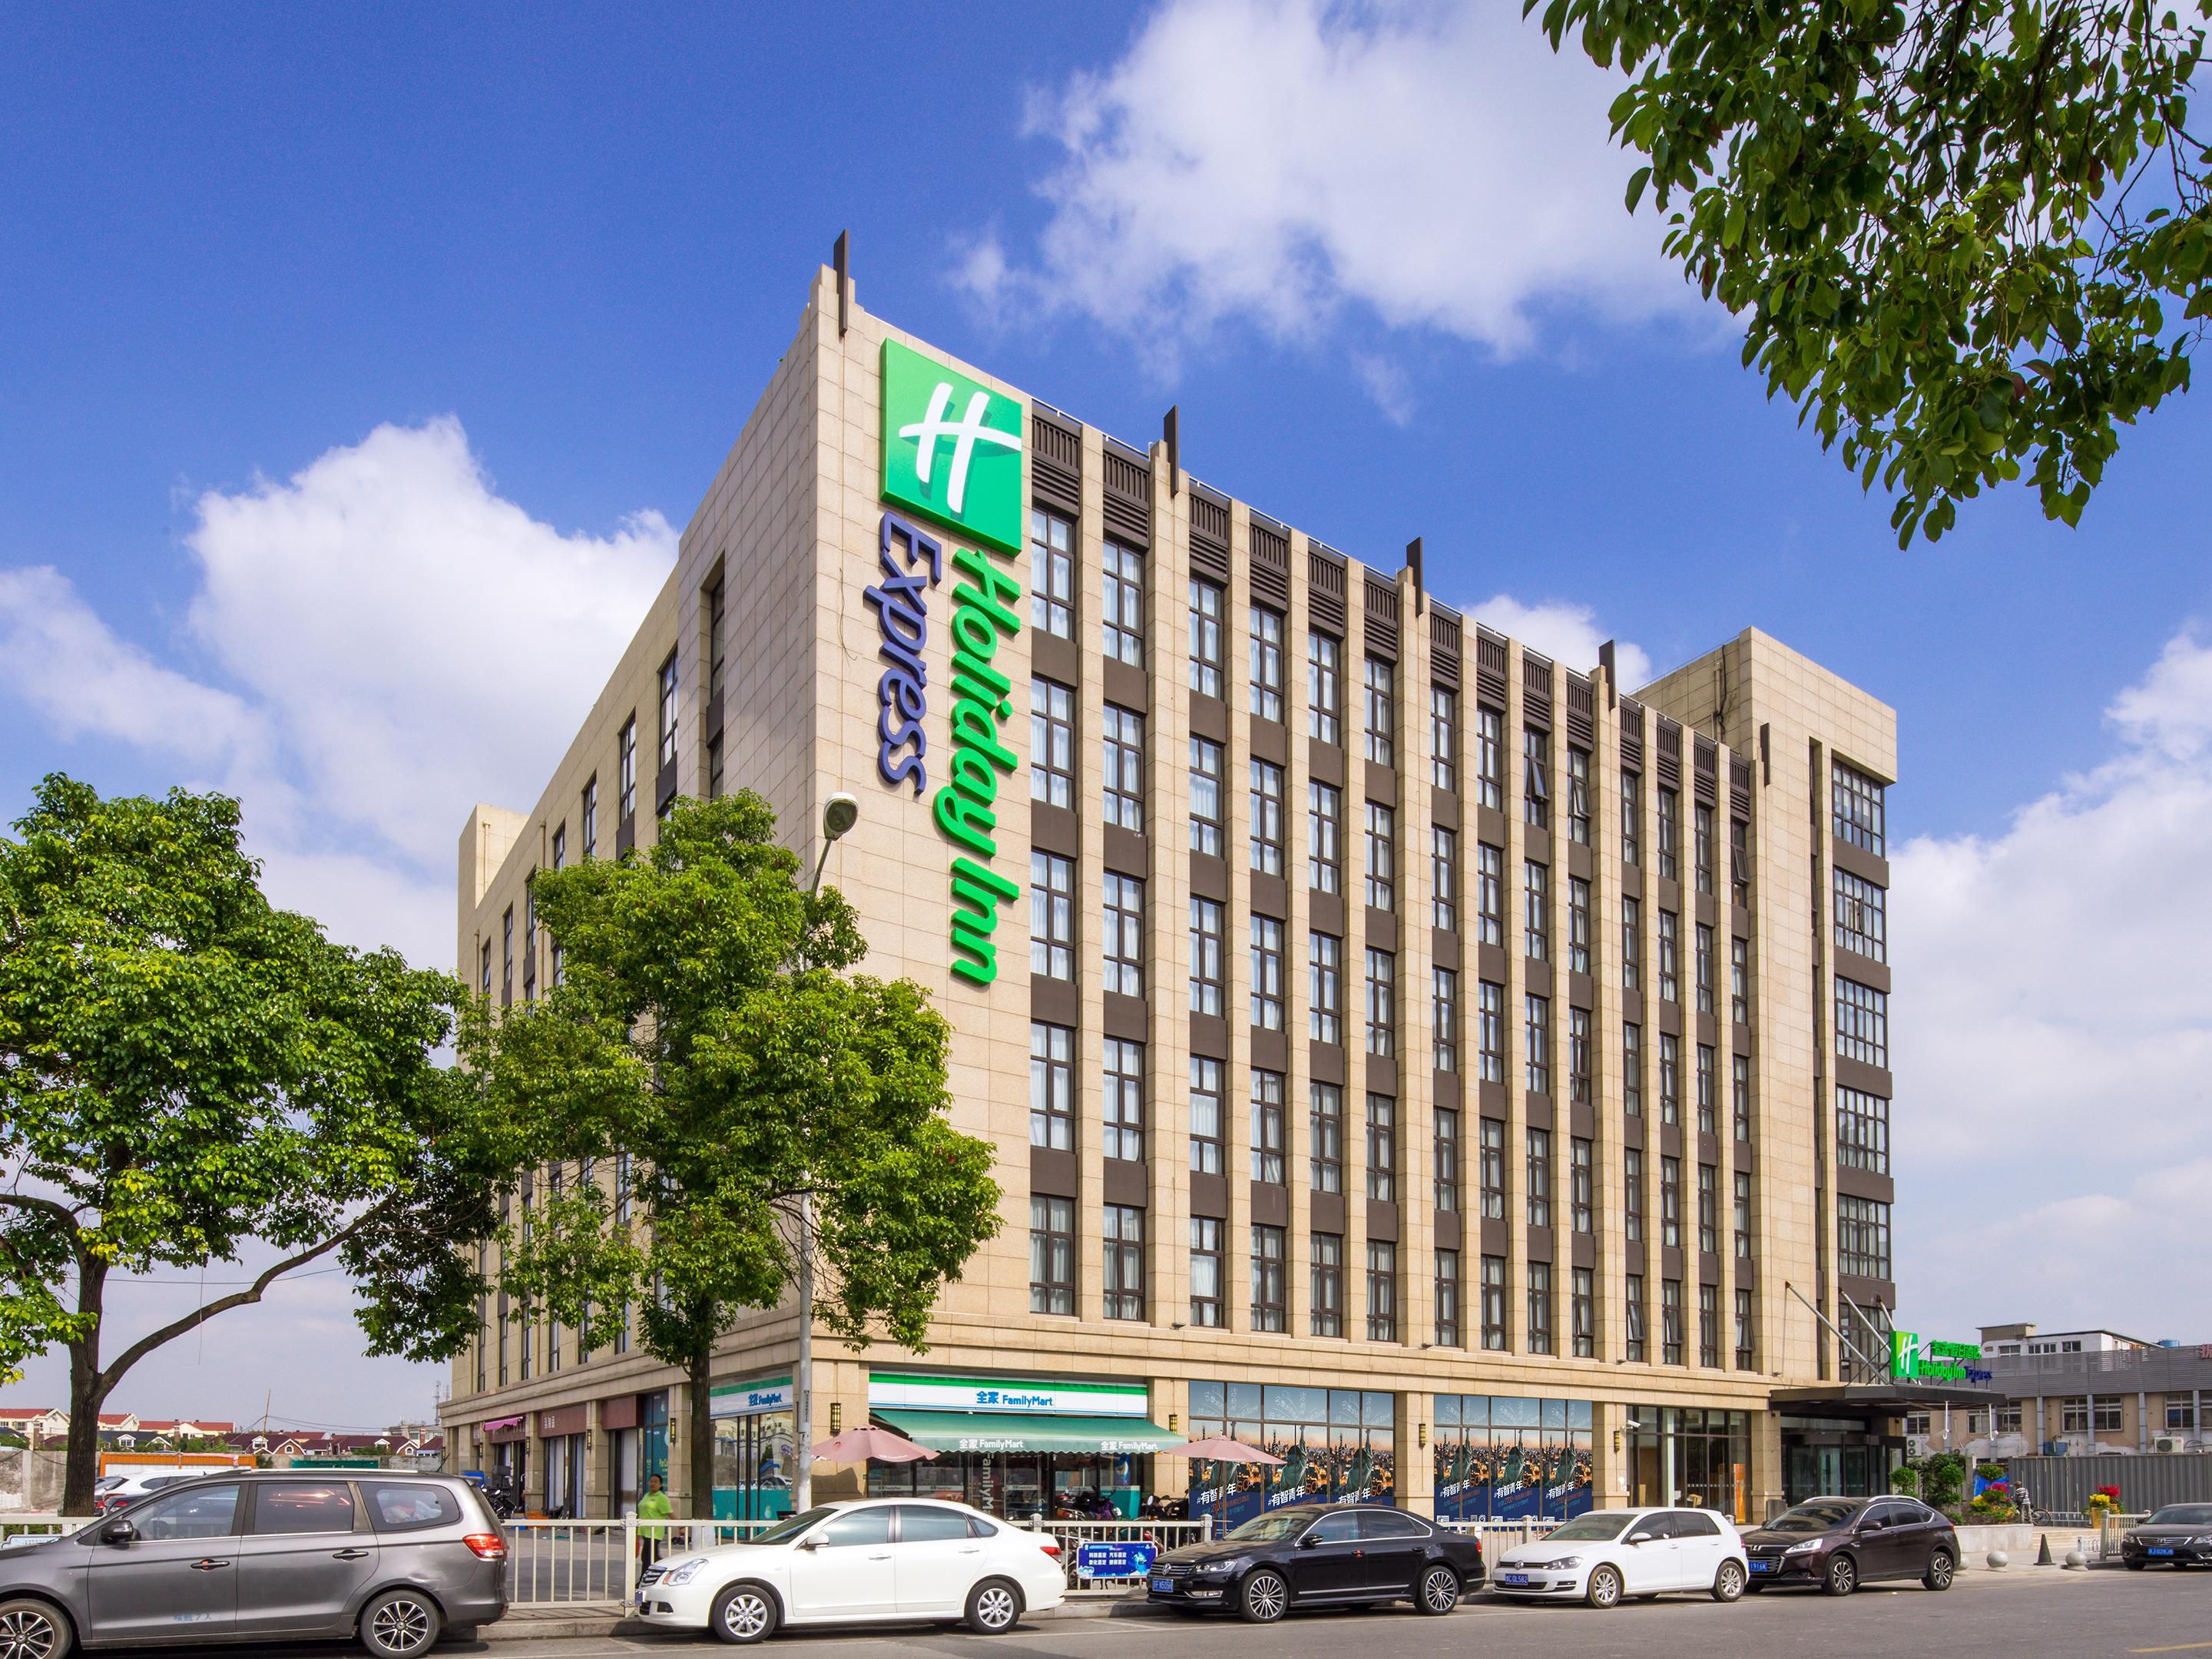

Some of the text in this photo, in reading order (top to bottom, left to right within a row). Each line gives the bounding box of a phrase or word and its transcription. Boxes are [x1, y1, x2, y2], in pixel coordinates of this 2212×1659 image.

[863, 510, 942, 797] Express
[933, 547, 1021, 987] Holiday Inn
[1919, 1359, 1952, 1382] Holiday
[1953, 1363, 1967, 1379] Inn
[976, 1391, 1053, 1407] 全家 FamilyMart
[959, 1439, 1024, 1449] 全家 FamilyMart
[1101, 1441, 1158, 1451] 全家 FamilyMart
[979, 1453, 995, 1514] FamilyM
